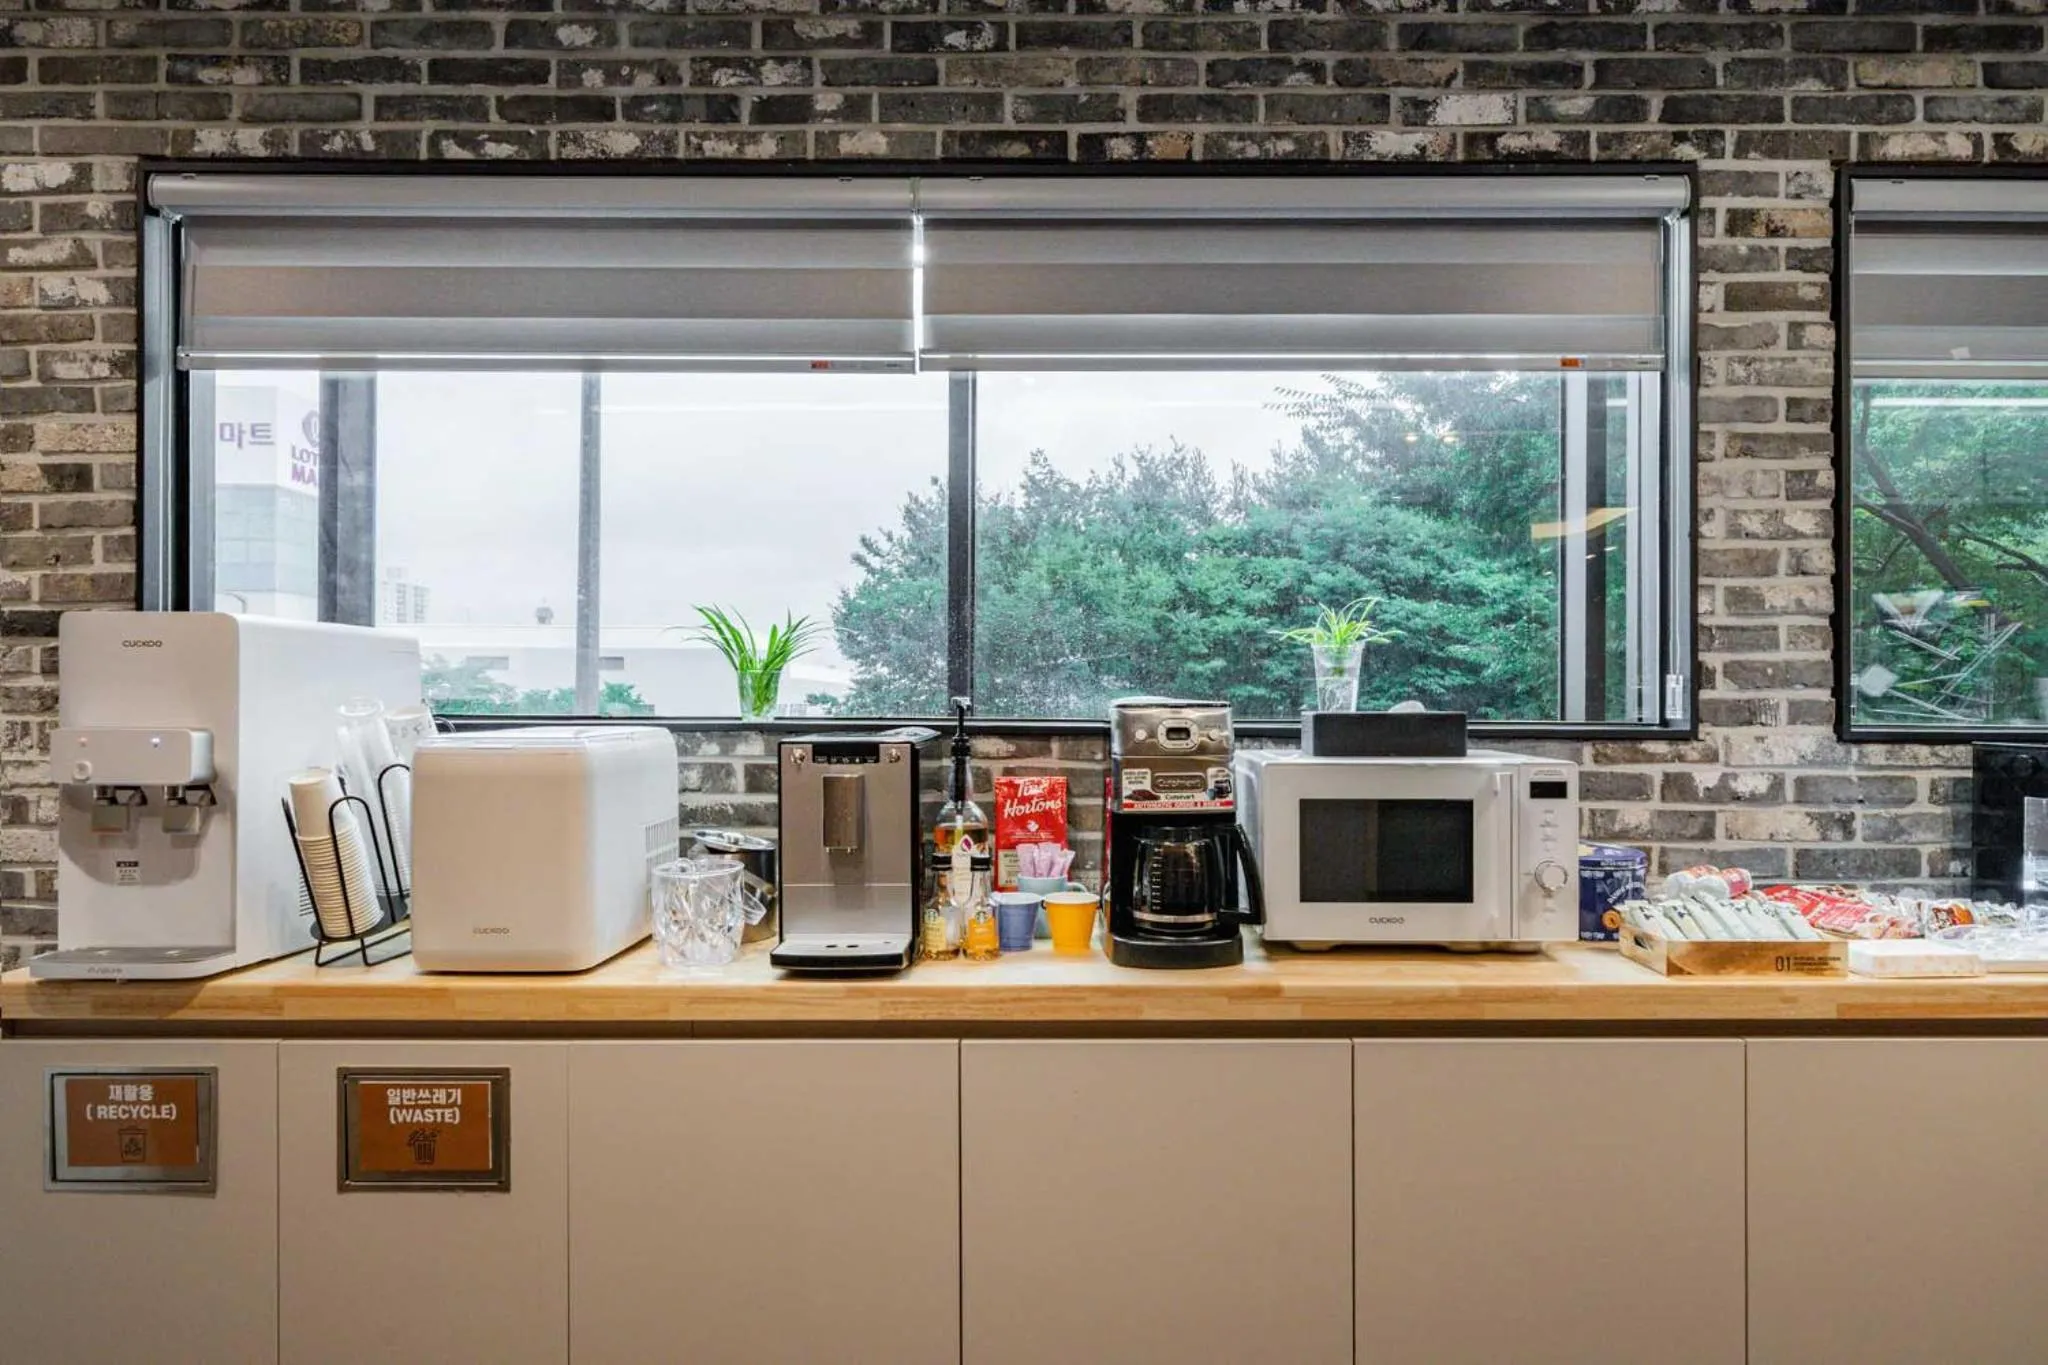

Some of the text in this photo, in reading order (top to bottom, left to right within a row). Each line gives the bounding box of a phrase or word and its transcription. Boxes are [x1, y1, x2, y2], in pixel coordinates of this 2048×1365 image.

[219, 421, 275, 449] 마트
[291, 444, 319, 466] LOT
[291, 463, 319, 486] MA
[121, 639, 163, 648] CUCKOO
[1003, 797, 1062, 819] Hortons
[1368, 916, 1405, 925] CUCKOO
[1775, 955, 1791, 972] 01
[108, 1084, 154, 1102] 재활용
[386, 1087, 462, 1106] 일반쓰레기
[389, 1107, 461, 1125] (WASTE)
